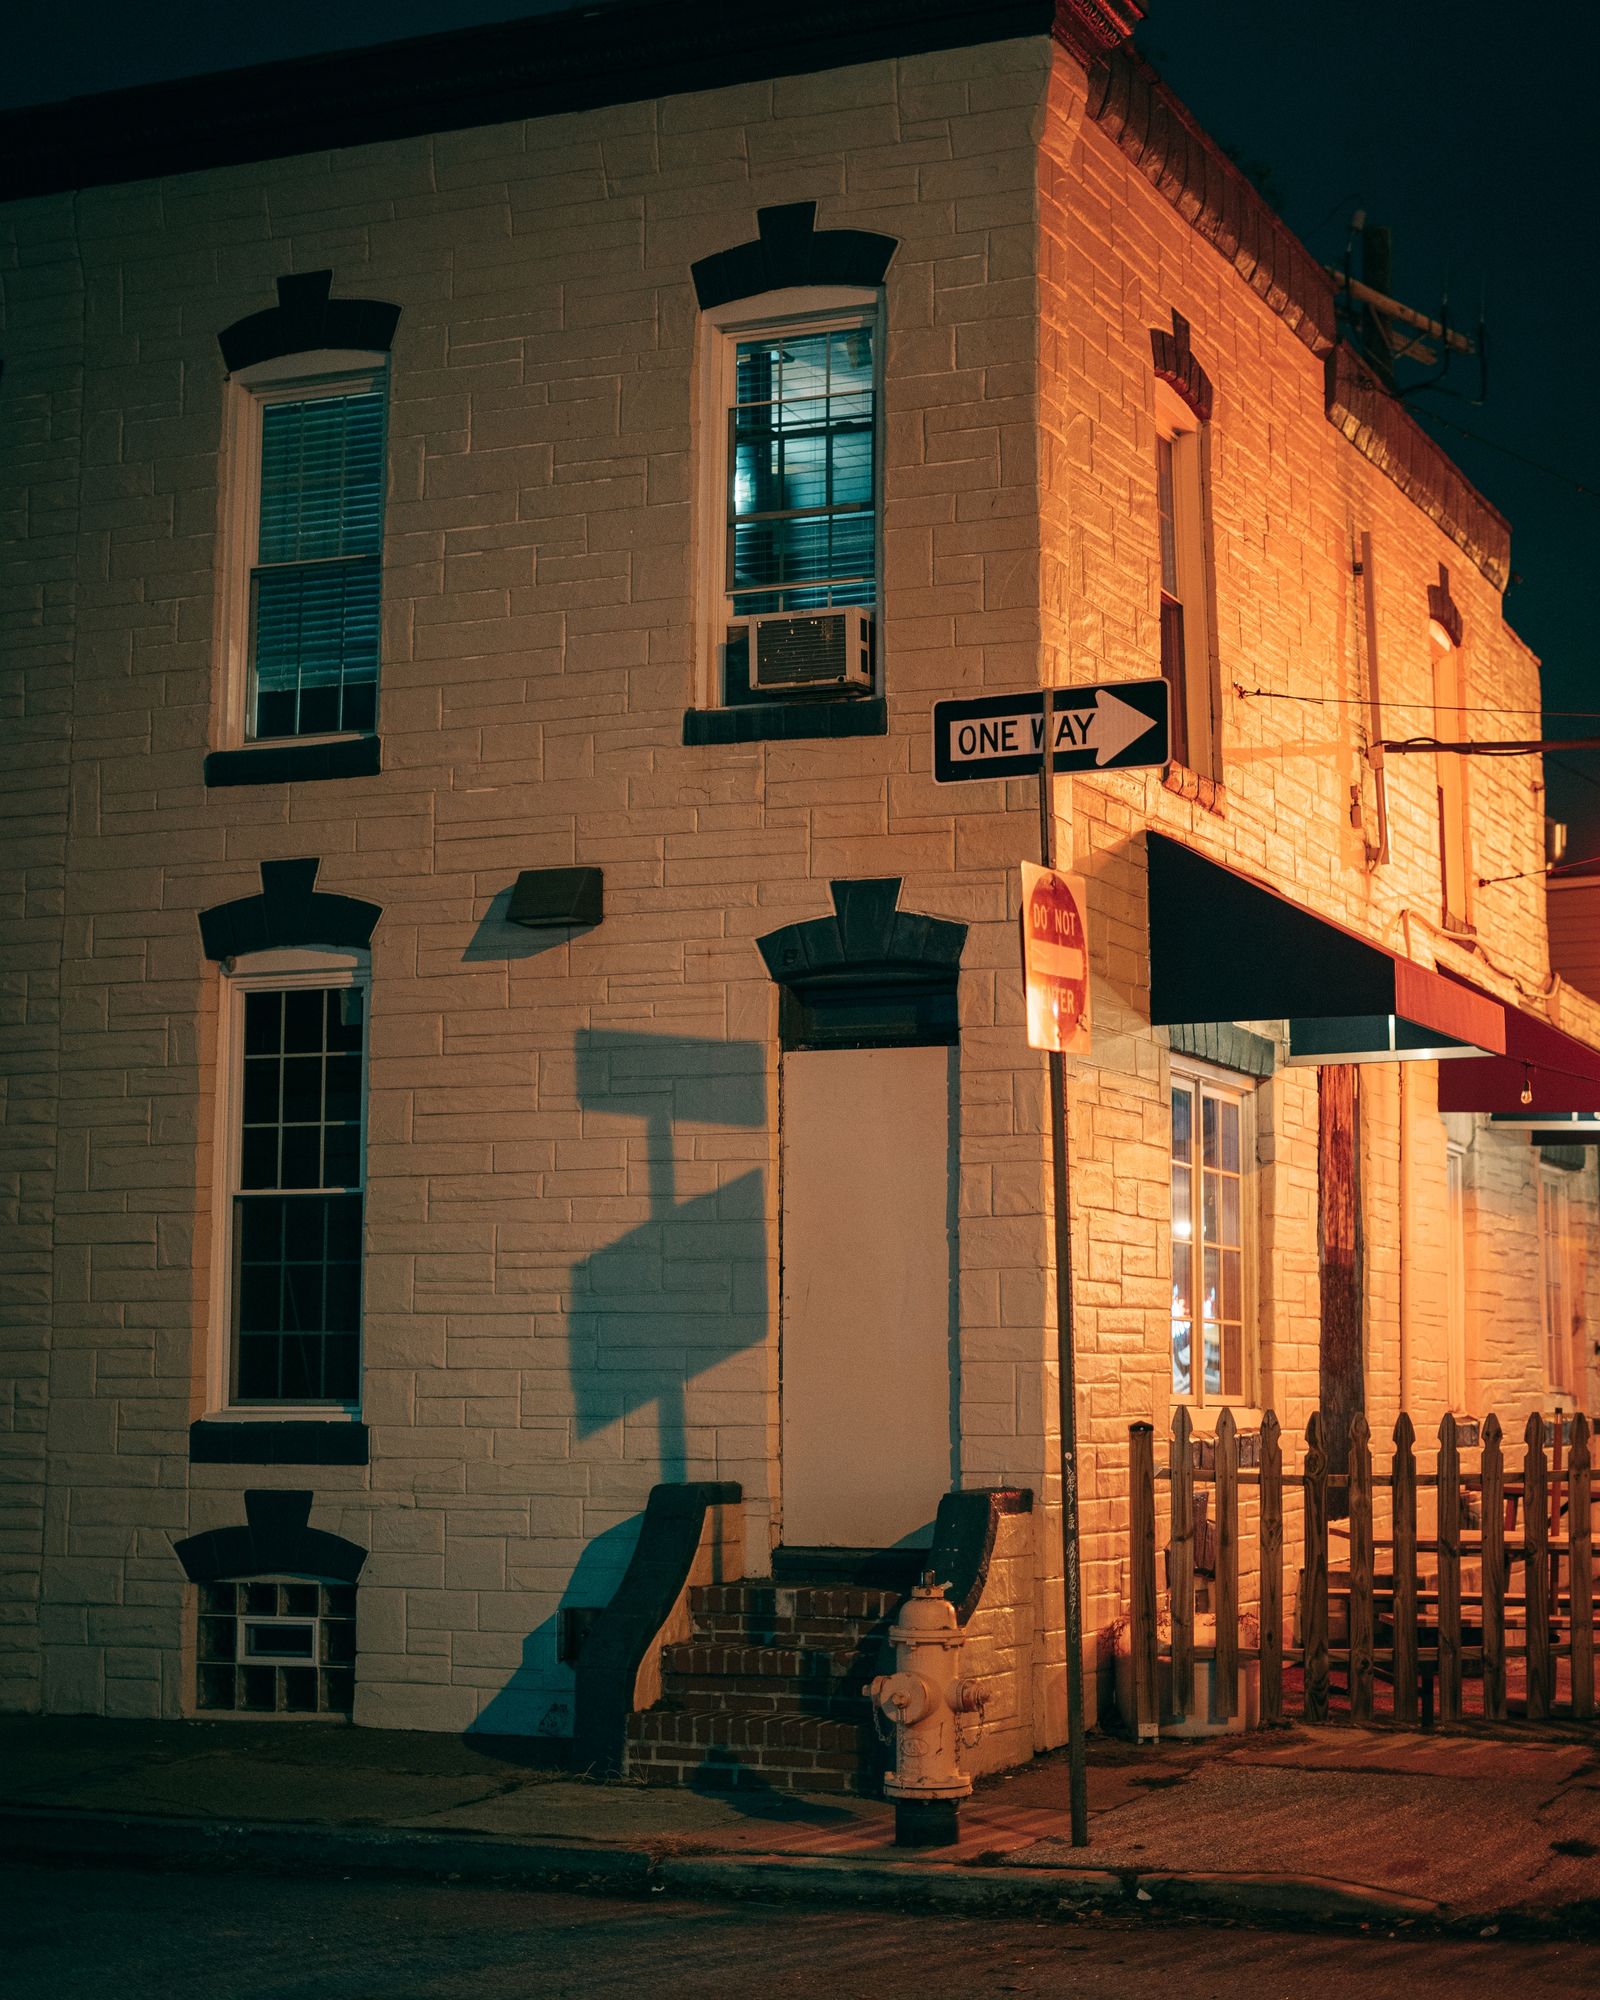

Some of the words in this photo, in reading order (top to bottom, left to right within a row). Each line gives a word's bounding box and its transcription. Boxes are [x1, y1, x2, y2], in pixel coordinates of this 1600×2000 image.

[958, 721, 1018, 755] ONE
[1033, 903, 1047, 930] DO
[1054, 910, 1075, 935] NOT
